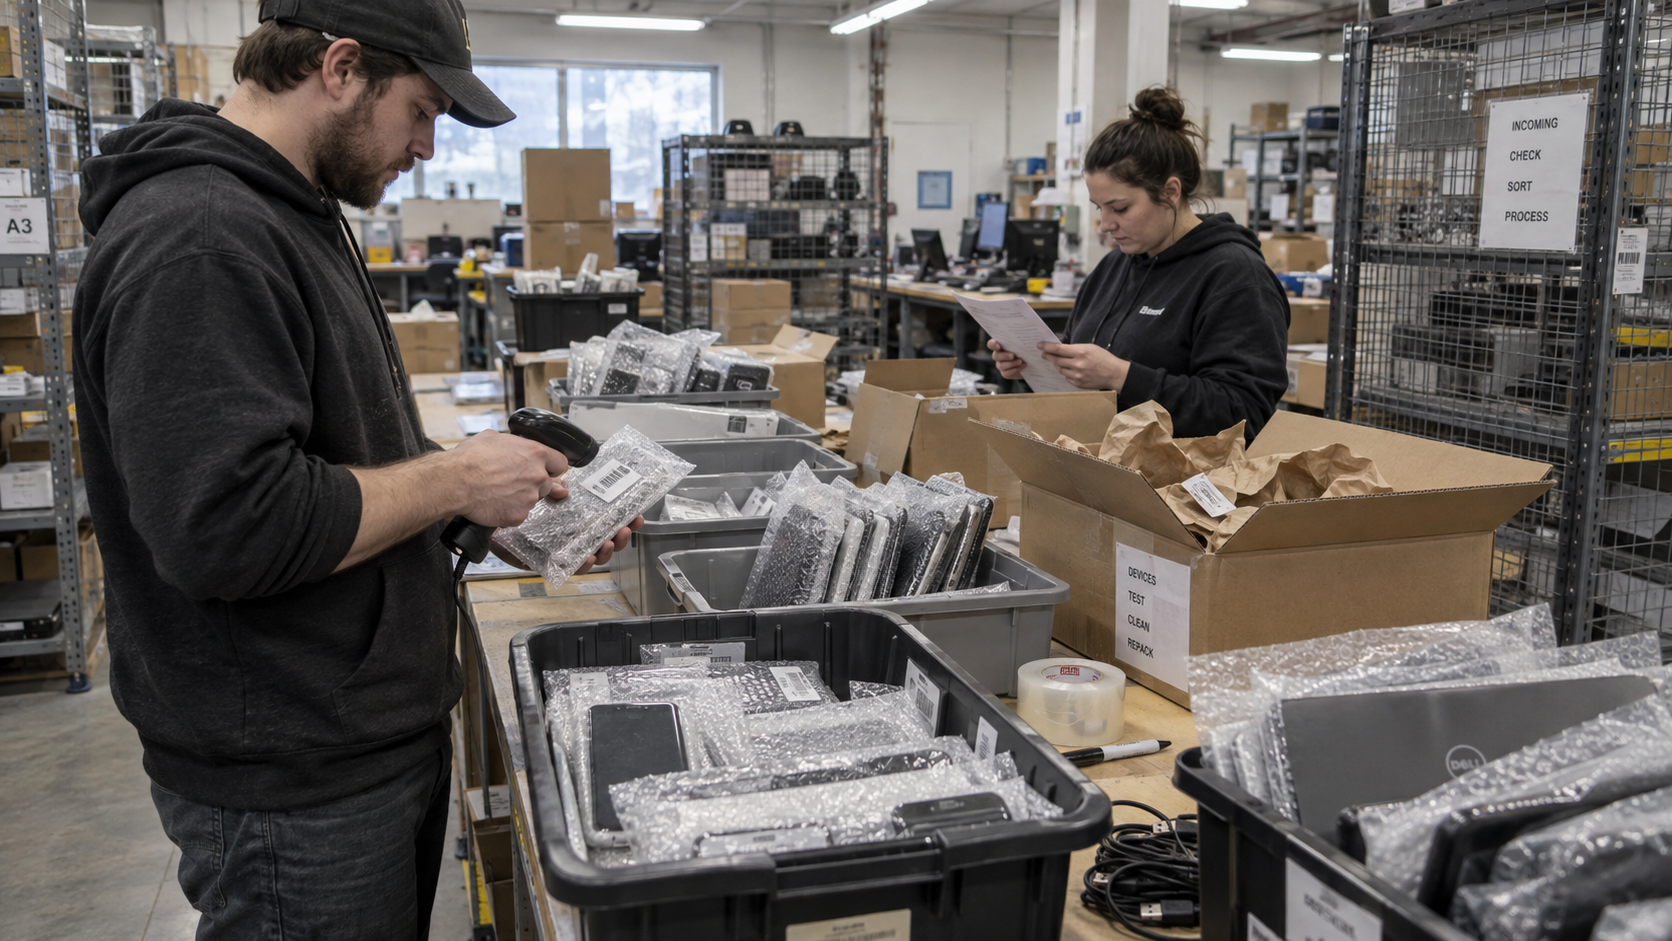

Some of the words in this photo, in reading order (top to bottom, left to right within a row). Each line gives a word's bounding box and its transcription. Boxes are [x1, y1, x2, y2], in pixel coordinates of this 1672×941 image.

[1511, 117, 1558, 131] INCOMING
[1509, 149, 1542, 161] CHECK
[1507, 181, 1533, 192] SORT
[1504, 211, 1549, 222] PROCESS
[6, 218, 32, 234] A3
[1128, 566, 1157, 585] DEVICES
[1127, 590, 1146, 606] TEST
[1127, 614, 1150, 633] CLEAN
[1127, 638, 1154, 658] REPACK
